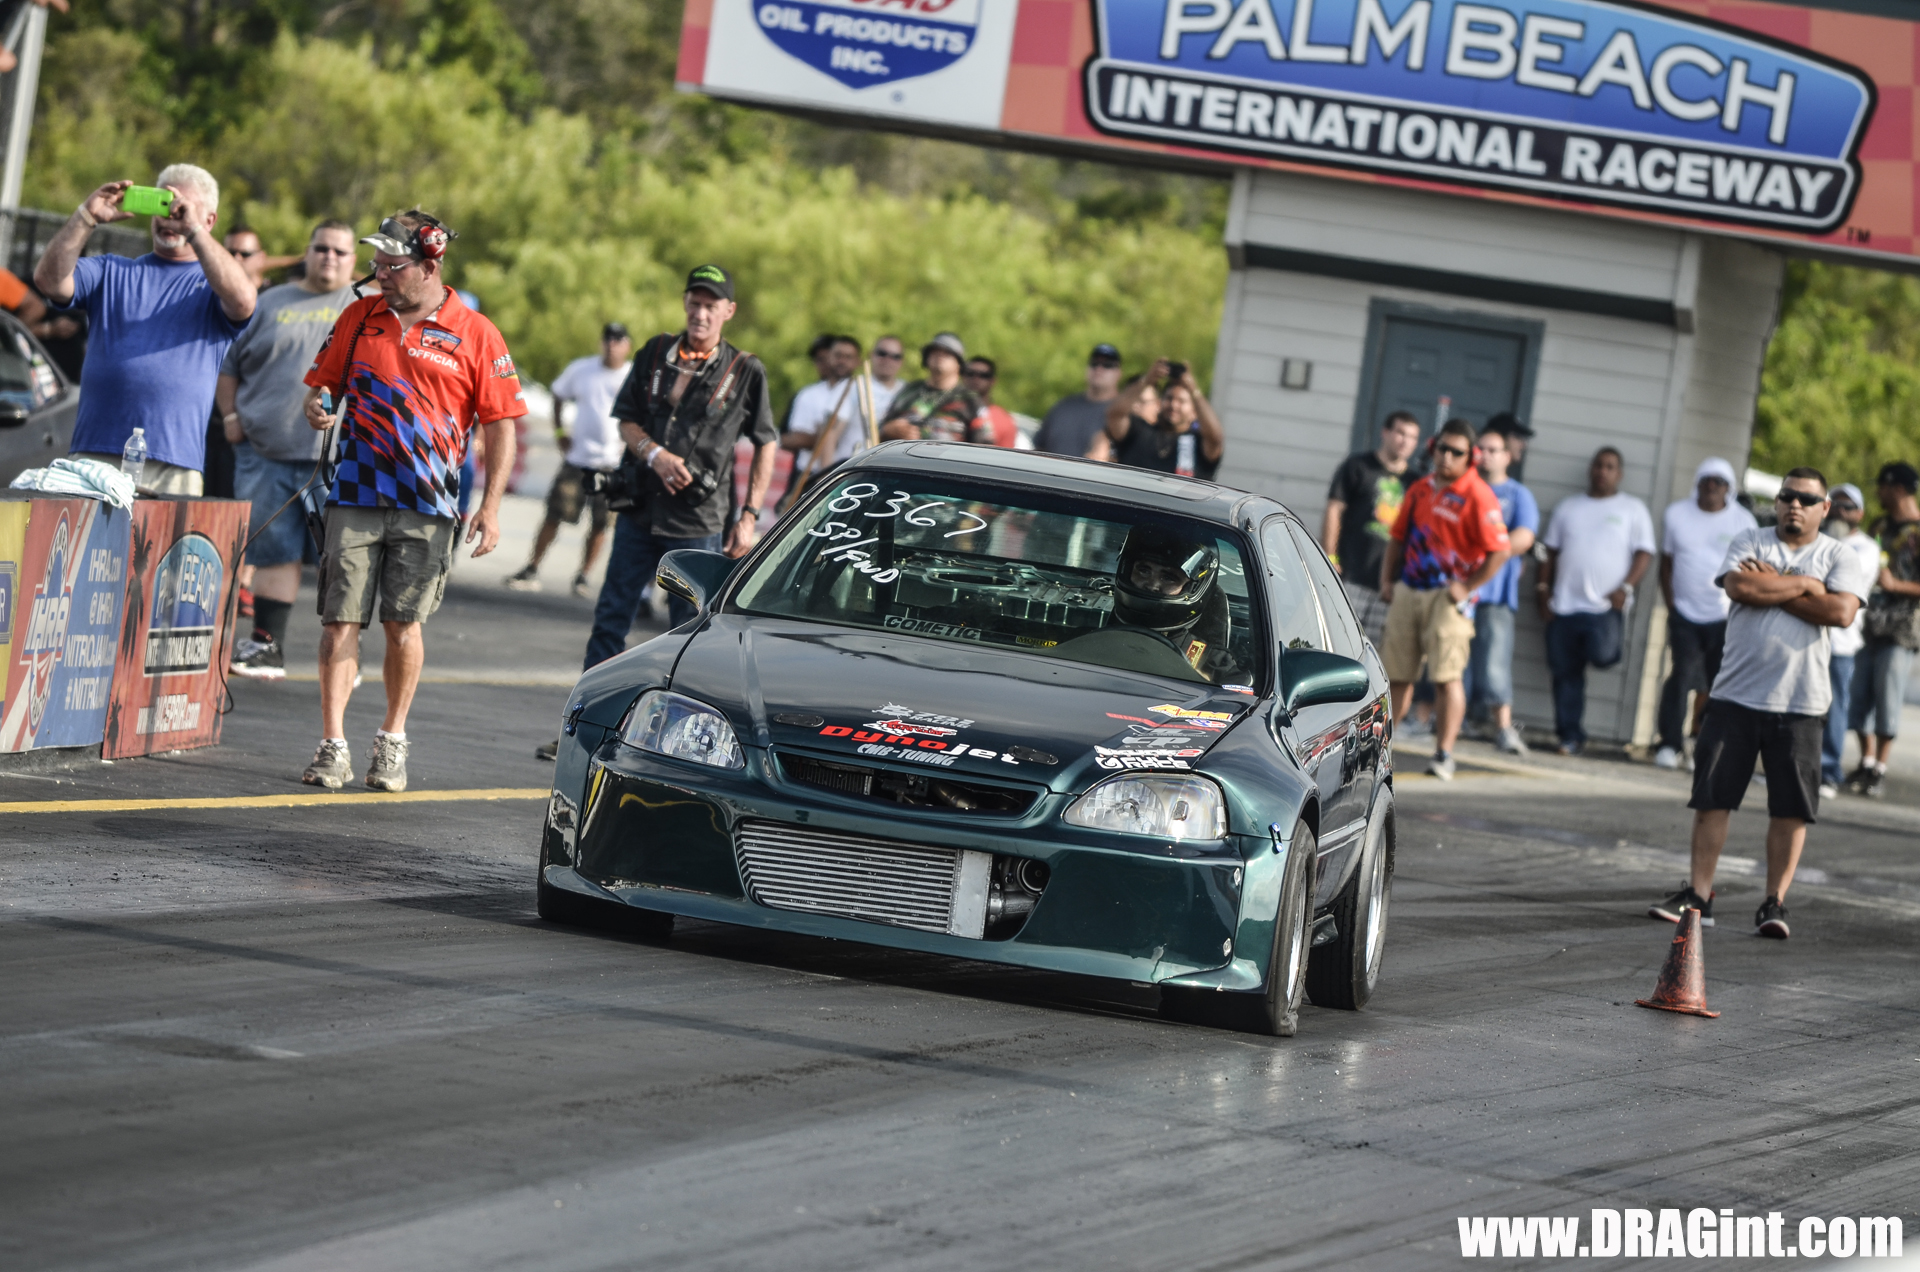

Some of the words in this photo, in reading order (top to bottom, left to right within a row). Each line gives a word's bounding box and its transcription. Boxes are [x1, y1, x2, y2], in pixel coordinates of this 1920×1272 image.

[758, 4, 809, 33] OIL
[813, 12, 967, 54] PRODUCTS
[831, 45, 890, 75] INC.
[1160, 0, 1432, 71] PALM
[1445, 4, 1796, 144] BEACH
[1109, 73, 1547, 176] INTERNATIONAL
[1561, 137, 1833, 212] RACEWAY
[1847, 226, 1871, 244] TM
[408, 347, 459, 371] OFFICIAL
[180, 553, 217, 618] BEACH
[25, 596, 70, 650] IHRA
[857, 743, 958, 767] CMB-TUNING
